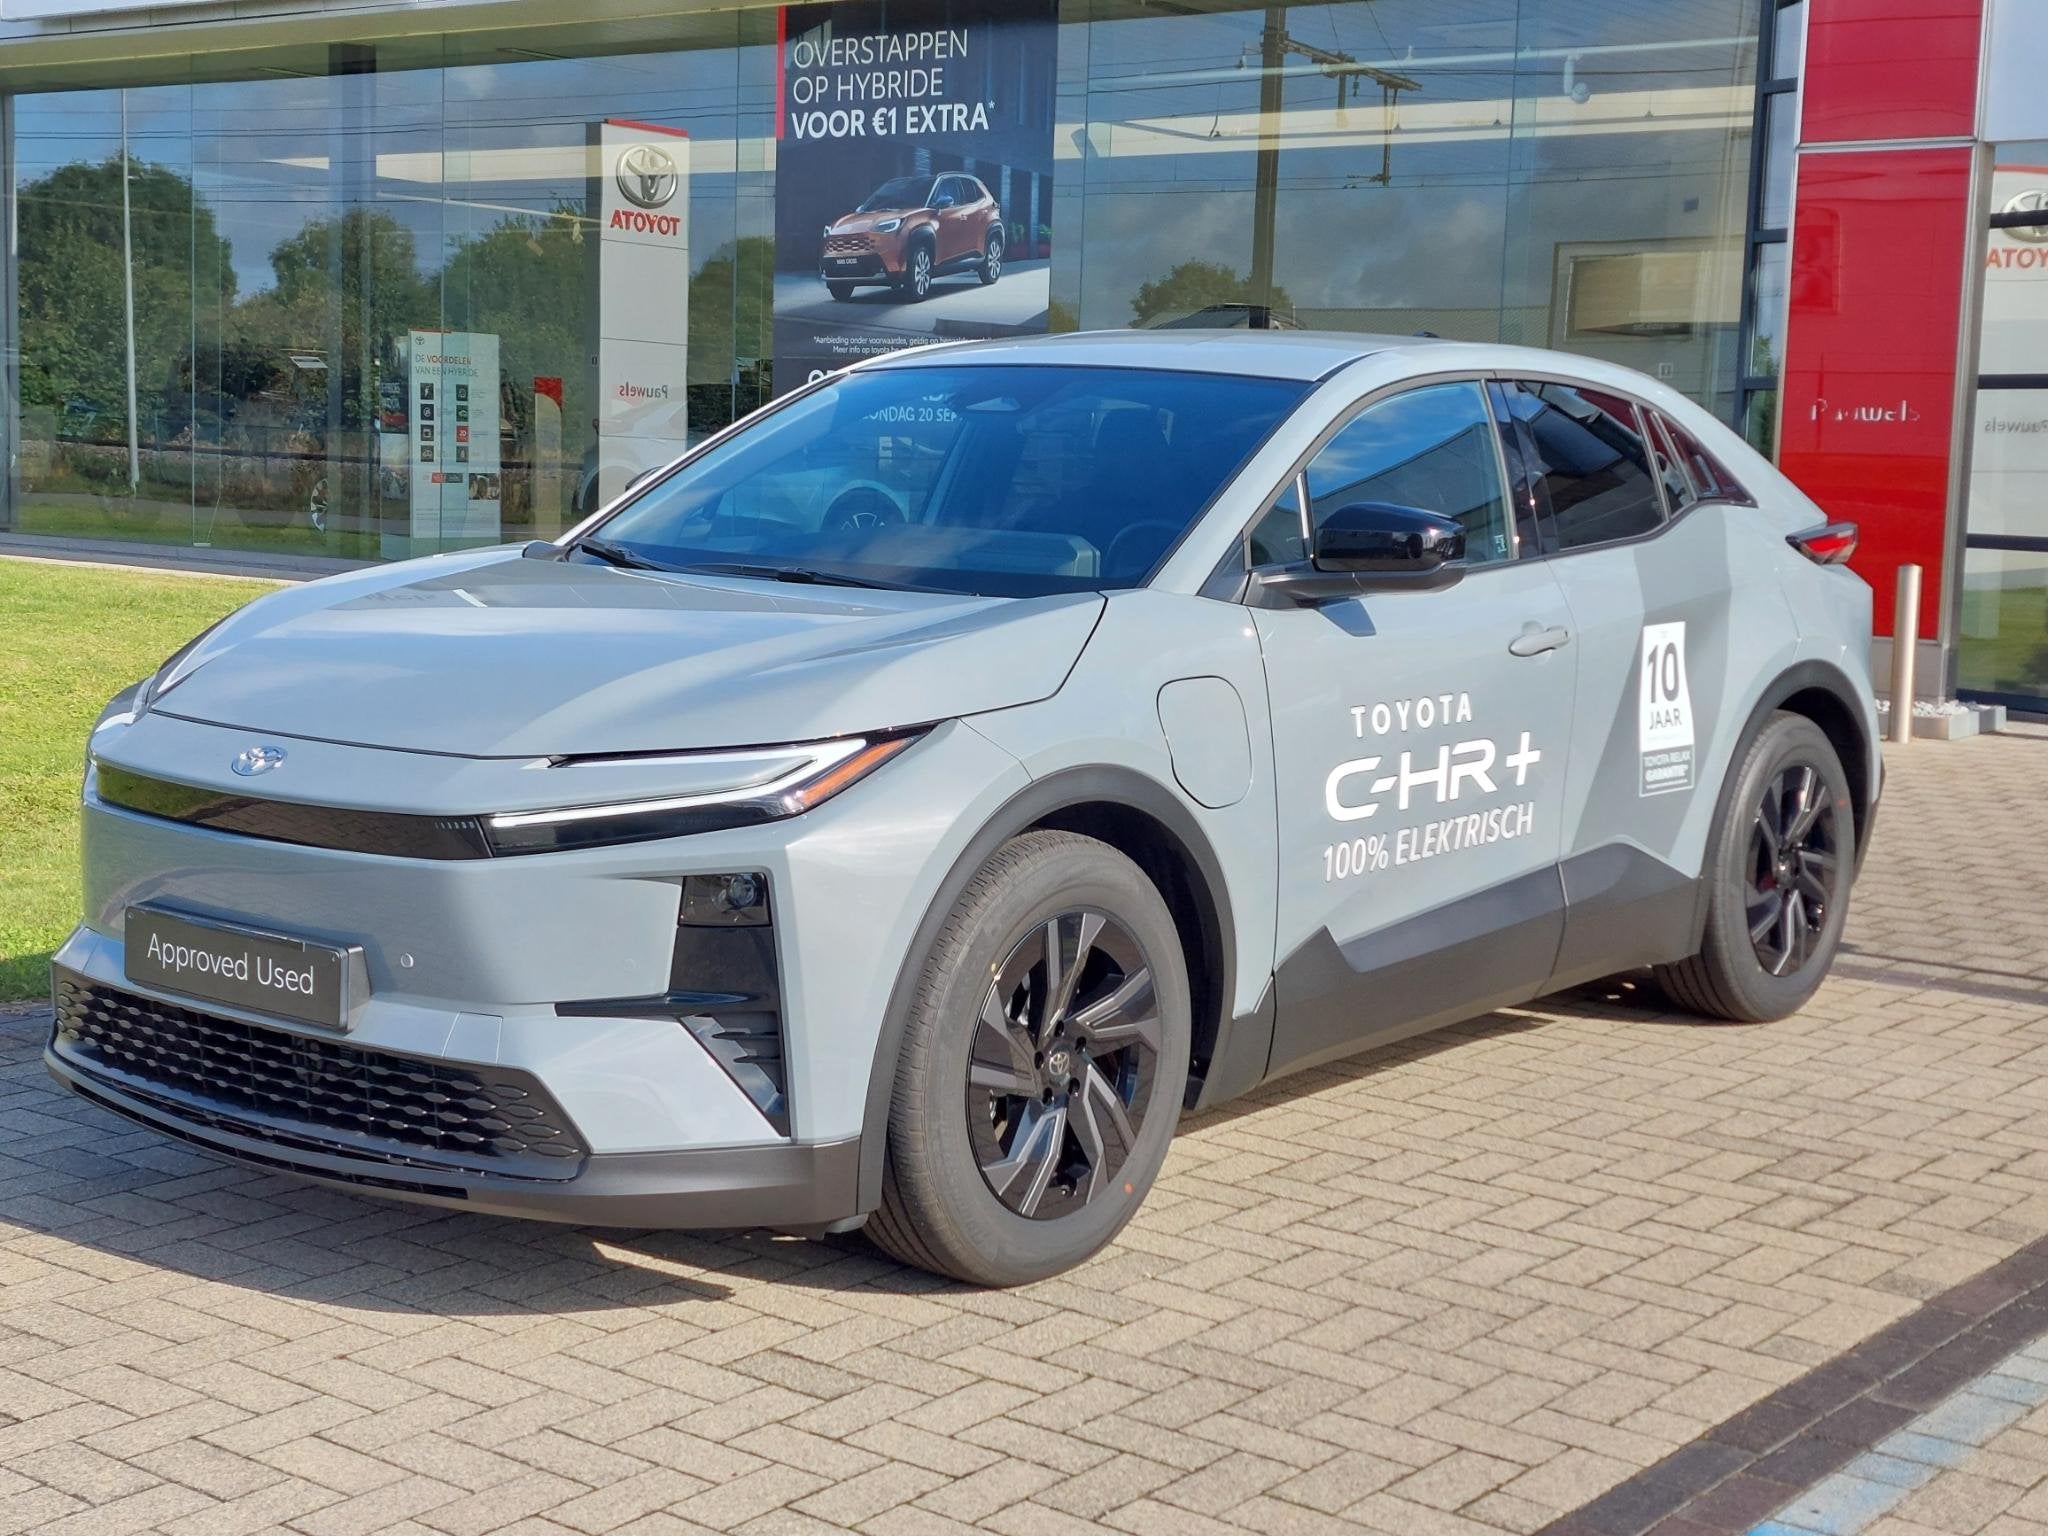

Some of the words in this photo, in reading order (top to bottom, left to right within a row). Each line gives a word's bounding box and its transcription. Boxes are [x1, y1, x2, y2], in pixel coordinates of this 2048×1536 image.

[793, 29, 968, 68] OVERSTAPPEN
[793, 74, 829, 104] OP
[837, 67, 944, 101] HYBRIDE
[791, 108, 866, 140] VOOR
[872, 107, 898, 136] €1
[917, 407, 934, 422] 20
[1647, 641, 1680, 704] 10
[1351, 691, 1473, 739] TOYOTA
[1649, 708, 1683, 731] JAAR
[1323, 833, 1390, 882] 100%
[1394, 801, 1535, 867] ELEKTRISCH
[147, 932, 249, 981] Approved
[256, 956, 314, 996] Used
